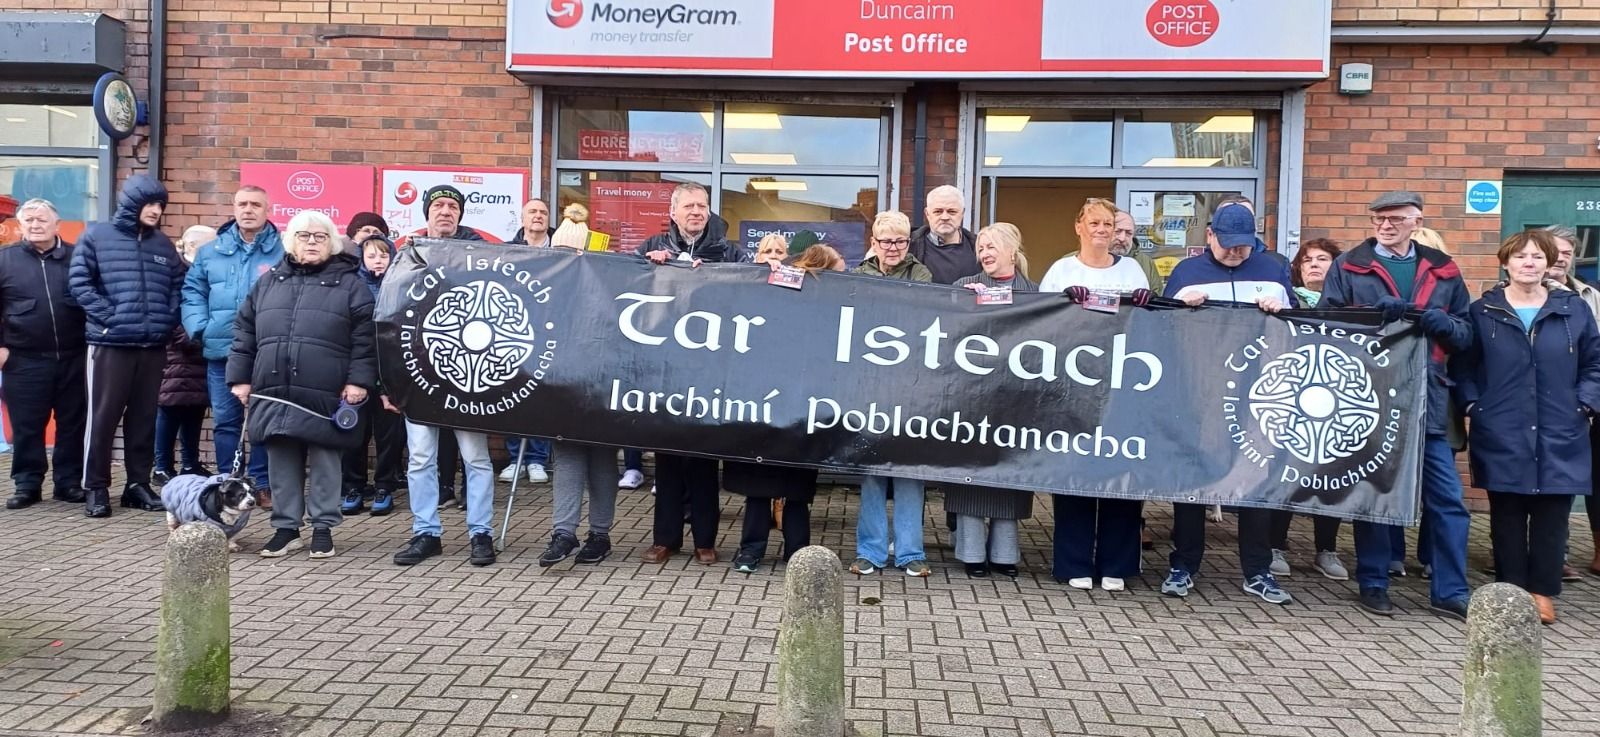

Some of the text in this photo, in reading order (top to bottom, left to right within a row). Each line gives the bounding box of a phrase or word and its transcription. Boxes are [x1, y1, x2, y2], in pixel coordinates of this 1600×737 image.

[591, 3, 737, 29] MoneyGram
[860, 0, 954, 20] Duncairn
[1162, 5, 1208, 19] POST
[590, 29, 694, 44] money transfer
[1153, 21, 1212, 36] OFFICE
[845, 33, 968, 53] Post Office
[1345, 72, 1369, 80] CBRE
[292, 185, 320, 194] OFFICE
[296, 177, 317, 186] POST
[596, 186, 622, 196] Travel
[623, 189, 653, 200] money
[406, 254, 552, 304] Tar Isteach
[614, 292, 1163, 393] Tar Isteach
[1224, 320, 1391, 373] Tar Isteach
[400, 324, 557, 416] Iarchimí Poblachtanacha
[610, 378, 1147, 460] Iarchimí Poblachtanacha
[1223, 396, 1401, 491] Iarchimí Poblachtanacha
